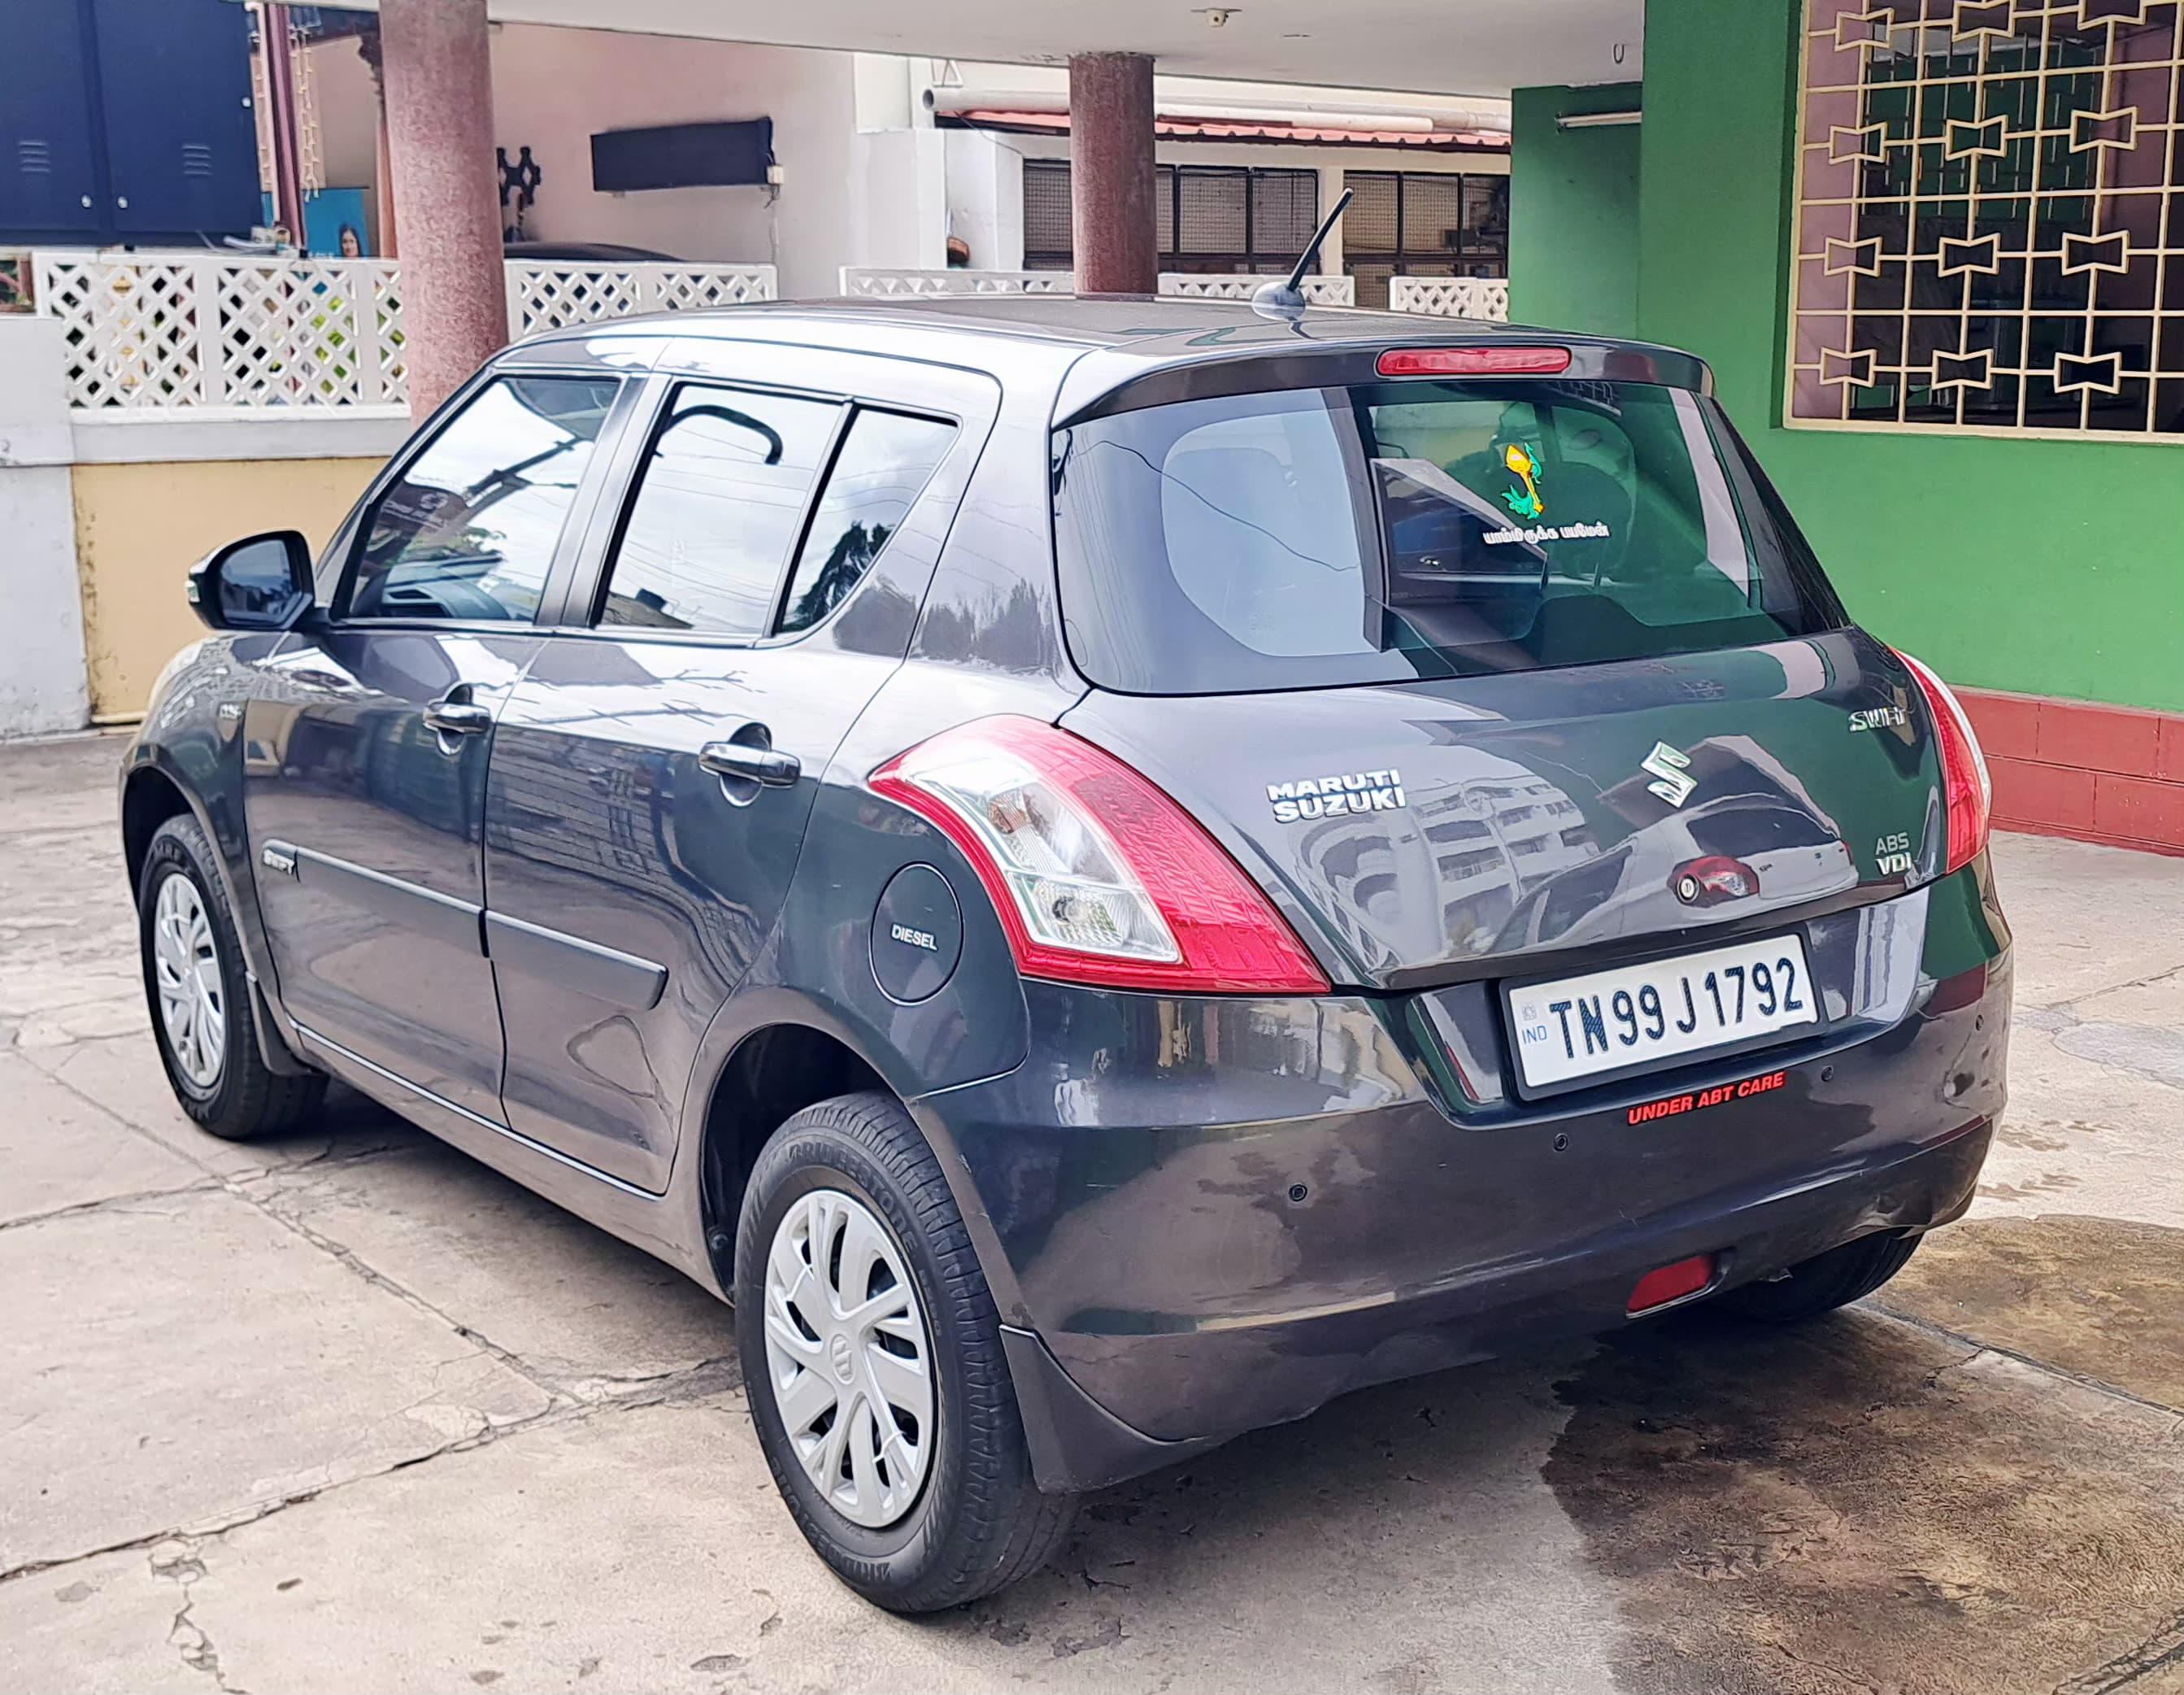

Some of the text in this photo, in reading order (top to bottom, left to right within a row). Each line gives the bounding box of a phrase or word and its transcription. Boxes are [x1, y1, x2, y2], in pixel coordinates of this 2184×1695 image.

[1267, 769, 1401, 801] MARUTI
[1273, 786, 1406, 823] SUZUKI
[1876, 832, 1909, 855] ABS
[891, 923, 938, 951] DIESEL
[1521, 1025, 1547, 1045] IND
[1628, 1071, 1786, 1126] UNDER ABT CARE
[788, 1142, 918, 1253] BRIDGESTONE
